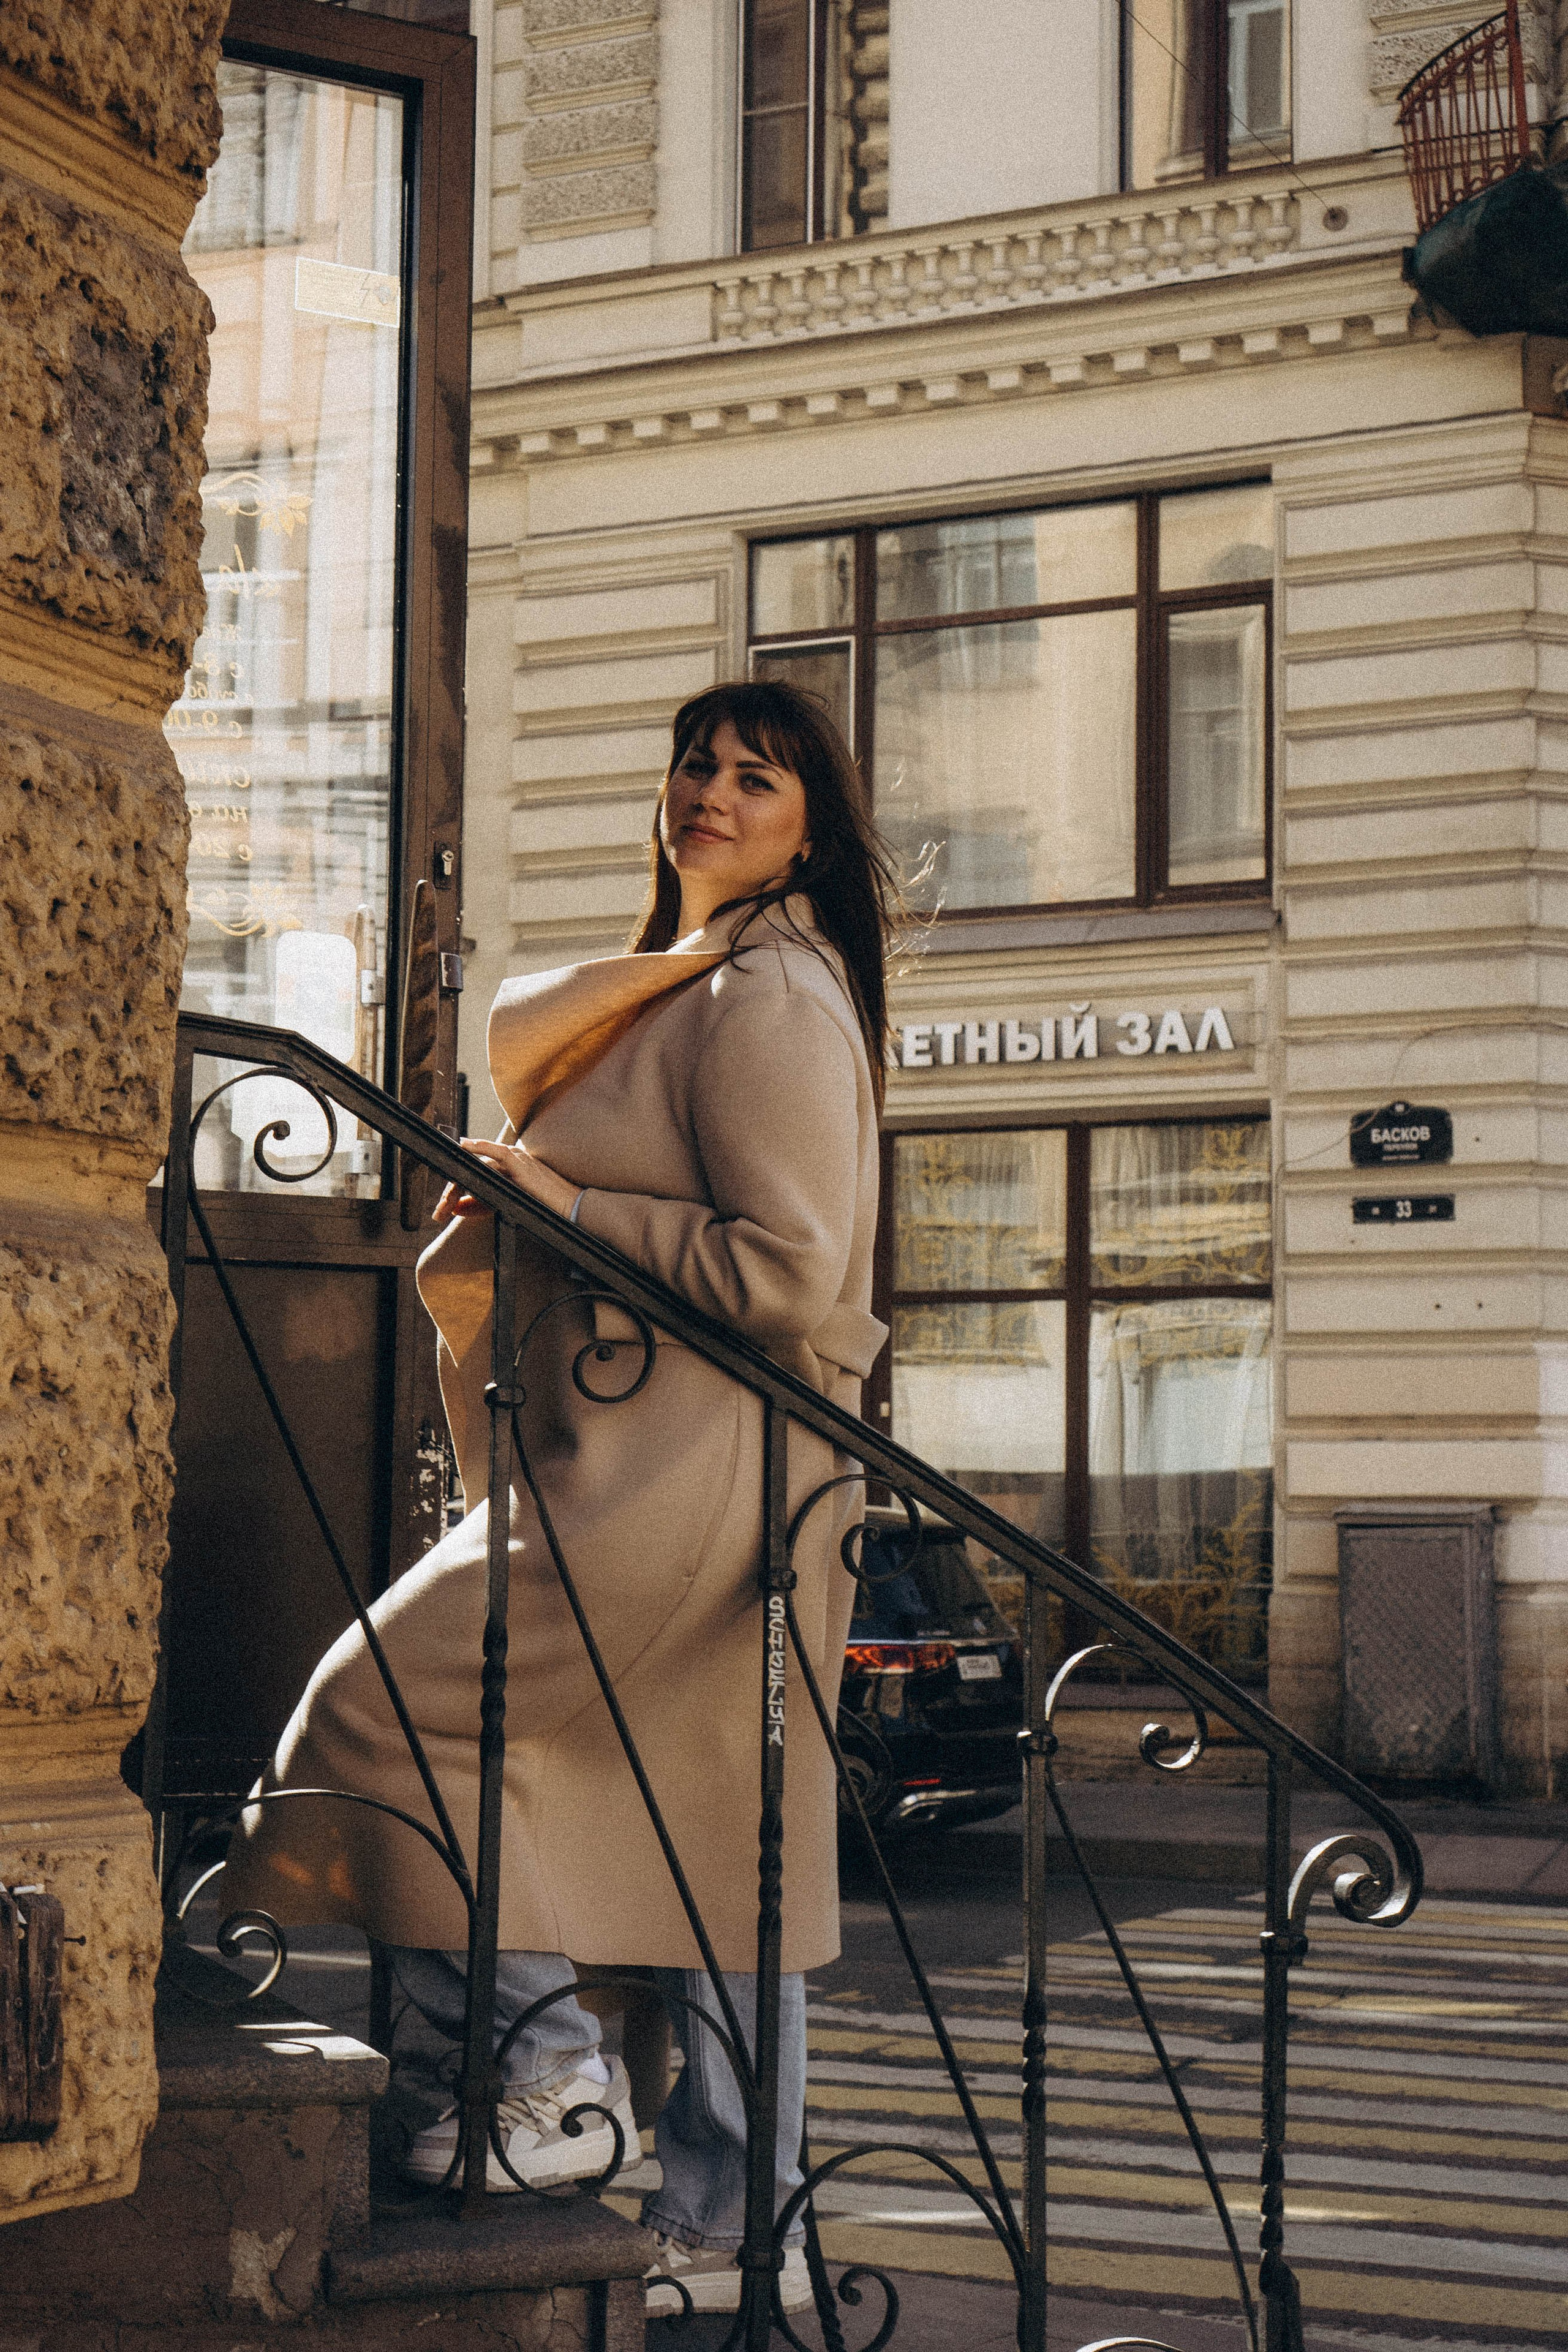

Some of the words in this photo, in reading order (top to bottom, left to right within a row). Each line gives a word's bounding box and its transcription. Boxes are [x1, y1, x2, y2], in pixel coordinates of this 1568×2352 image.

[1116, 1007, 1235, 1056] ЗАЛ
[1370, 1125, 1431, 1144] БАСКОВ
[1395, 1200, 1412, 1218] 33
